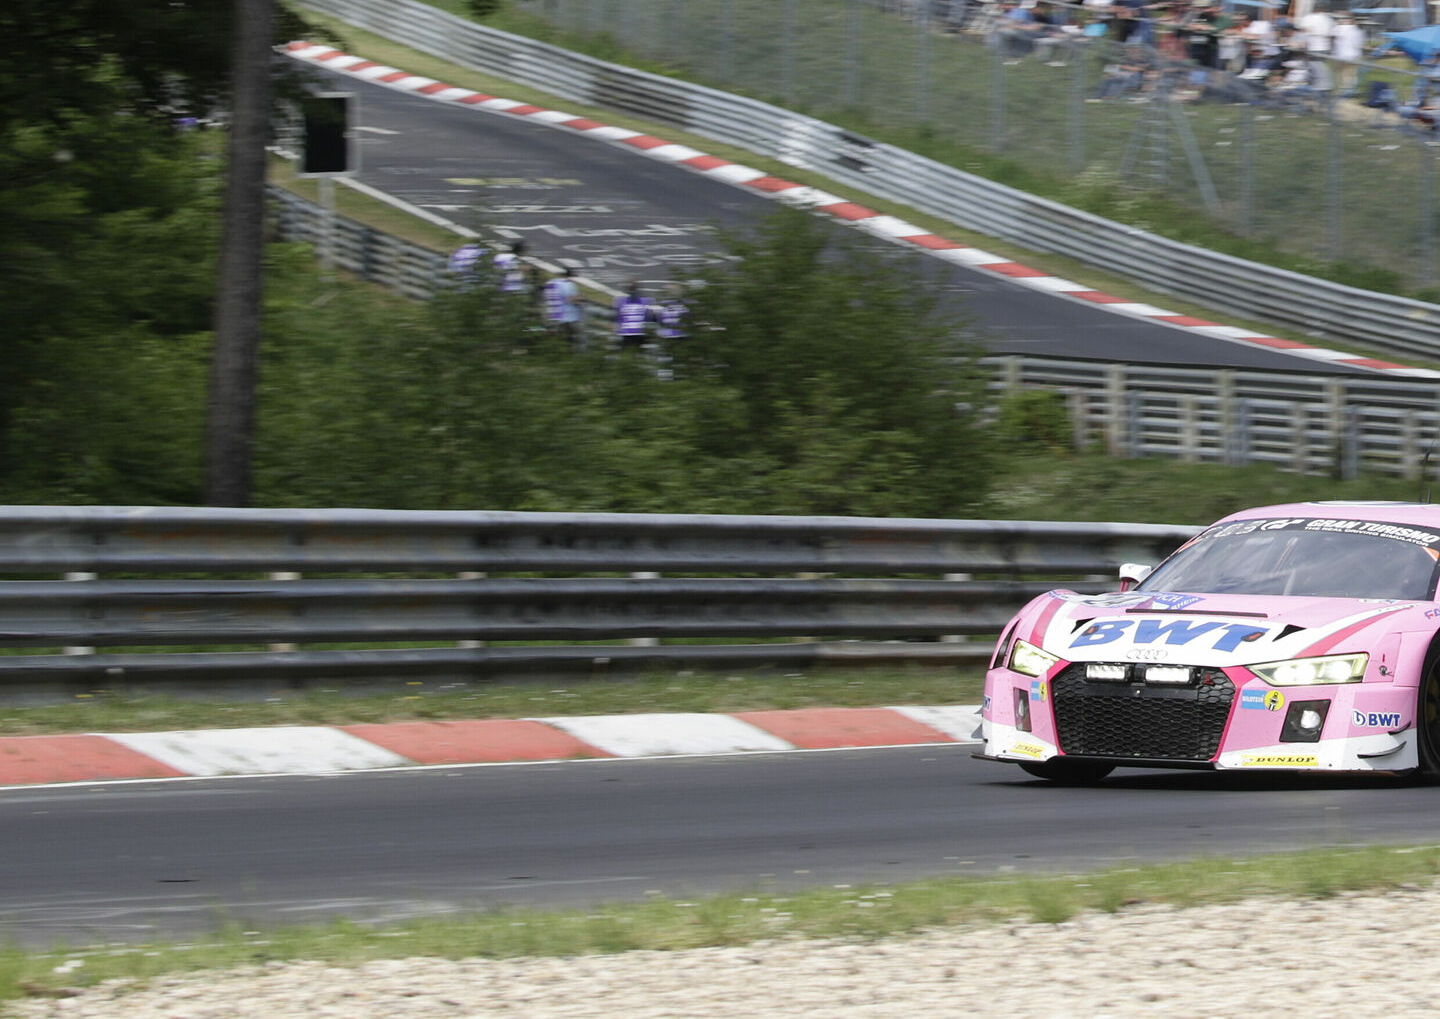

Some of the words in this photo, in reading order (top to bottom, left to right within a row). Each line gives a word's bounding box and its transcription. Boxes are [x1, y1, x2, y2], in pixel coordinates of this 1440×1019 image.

[1306, 519, 1361, 530] GRAN
[1358, 522, 1440, 544] TURISMO
[1344, 528, 1379, 536] DRIVING
[1380, 533, 1430, 547] SIMULATOR
[1067, 619, 1271, 653] BWT
[1368, 713, 1401, 727] BWT
